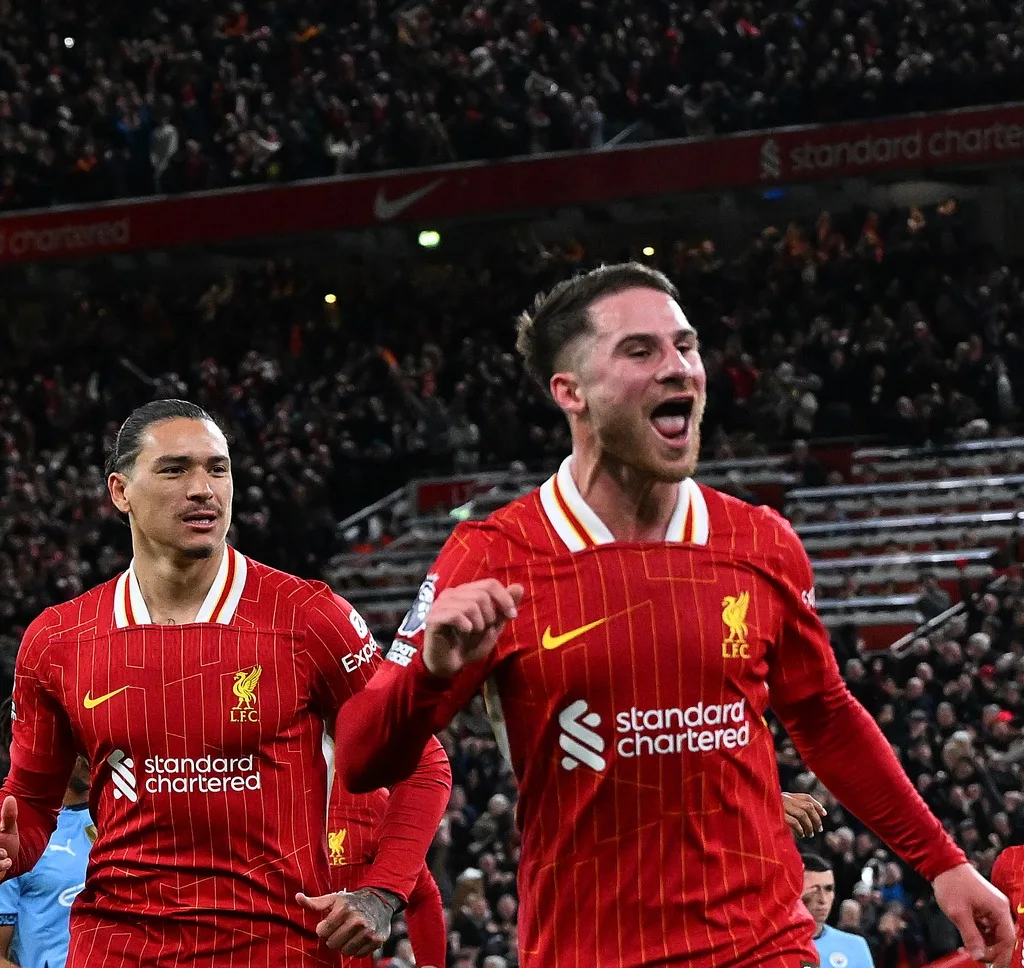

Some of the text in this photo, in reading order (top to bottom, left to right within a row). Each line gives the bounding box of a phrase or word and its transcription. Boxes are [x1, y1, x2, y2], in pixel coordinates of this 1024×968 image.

[791, 130, 920, 170] standard
[8, 215, 131, 255] chartered
[616, 697, 746, 733] standard
[617, 721, 750, 758] chartered
[144, 754, 253, 773] standard
[145, 771, 261, 793] chartered
